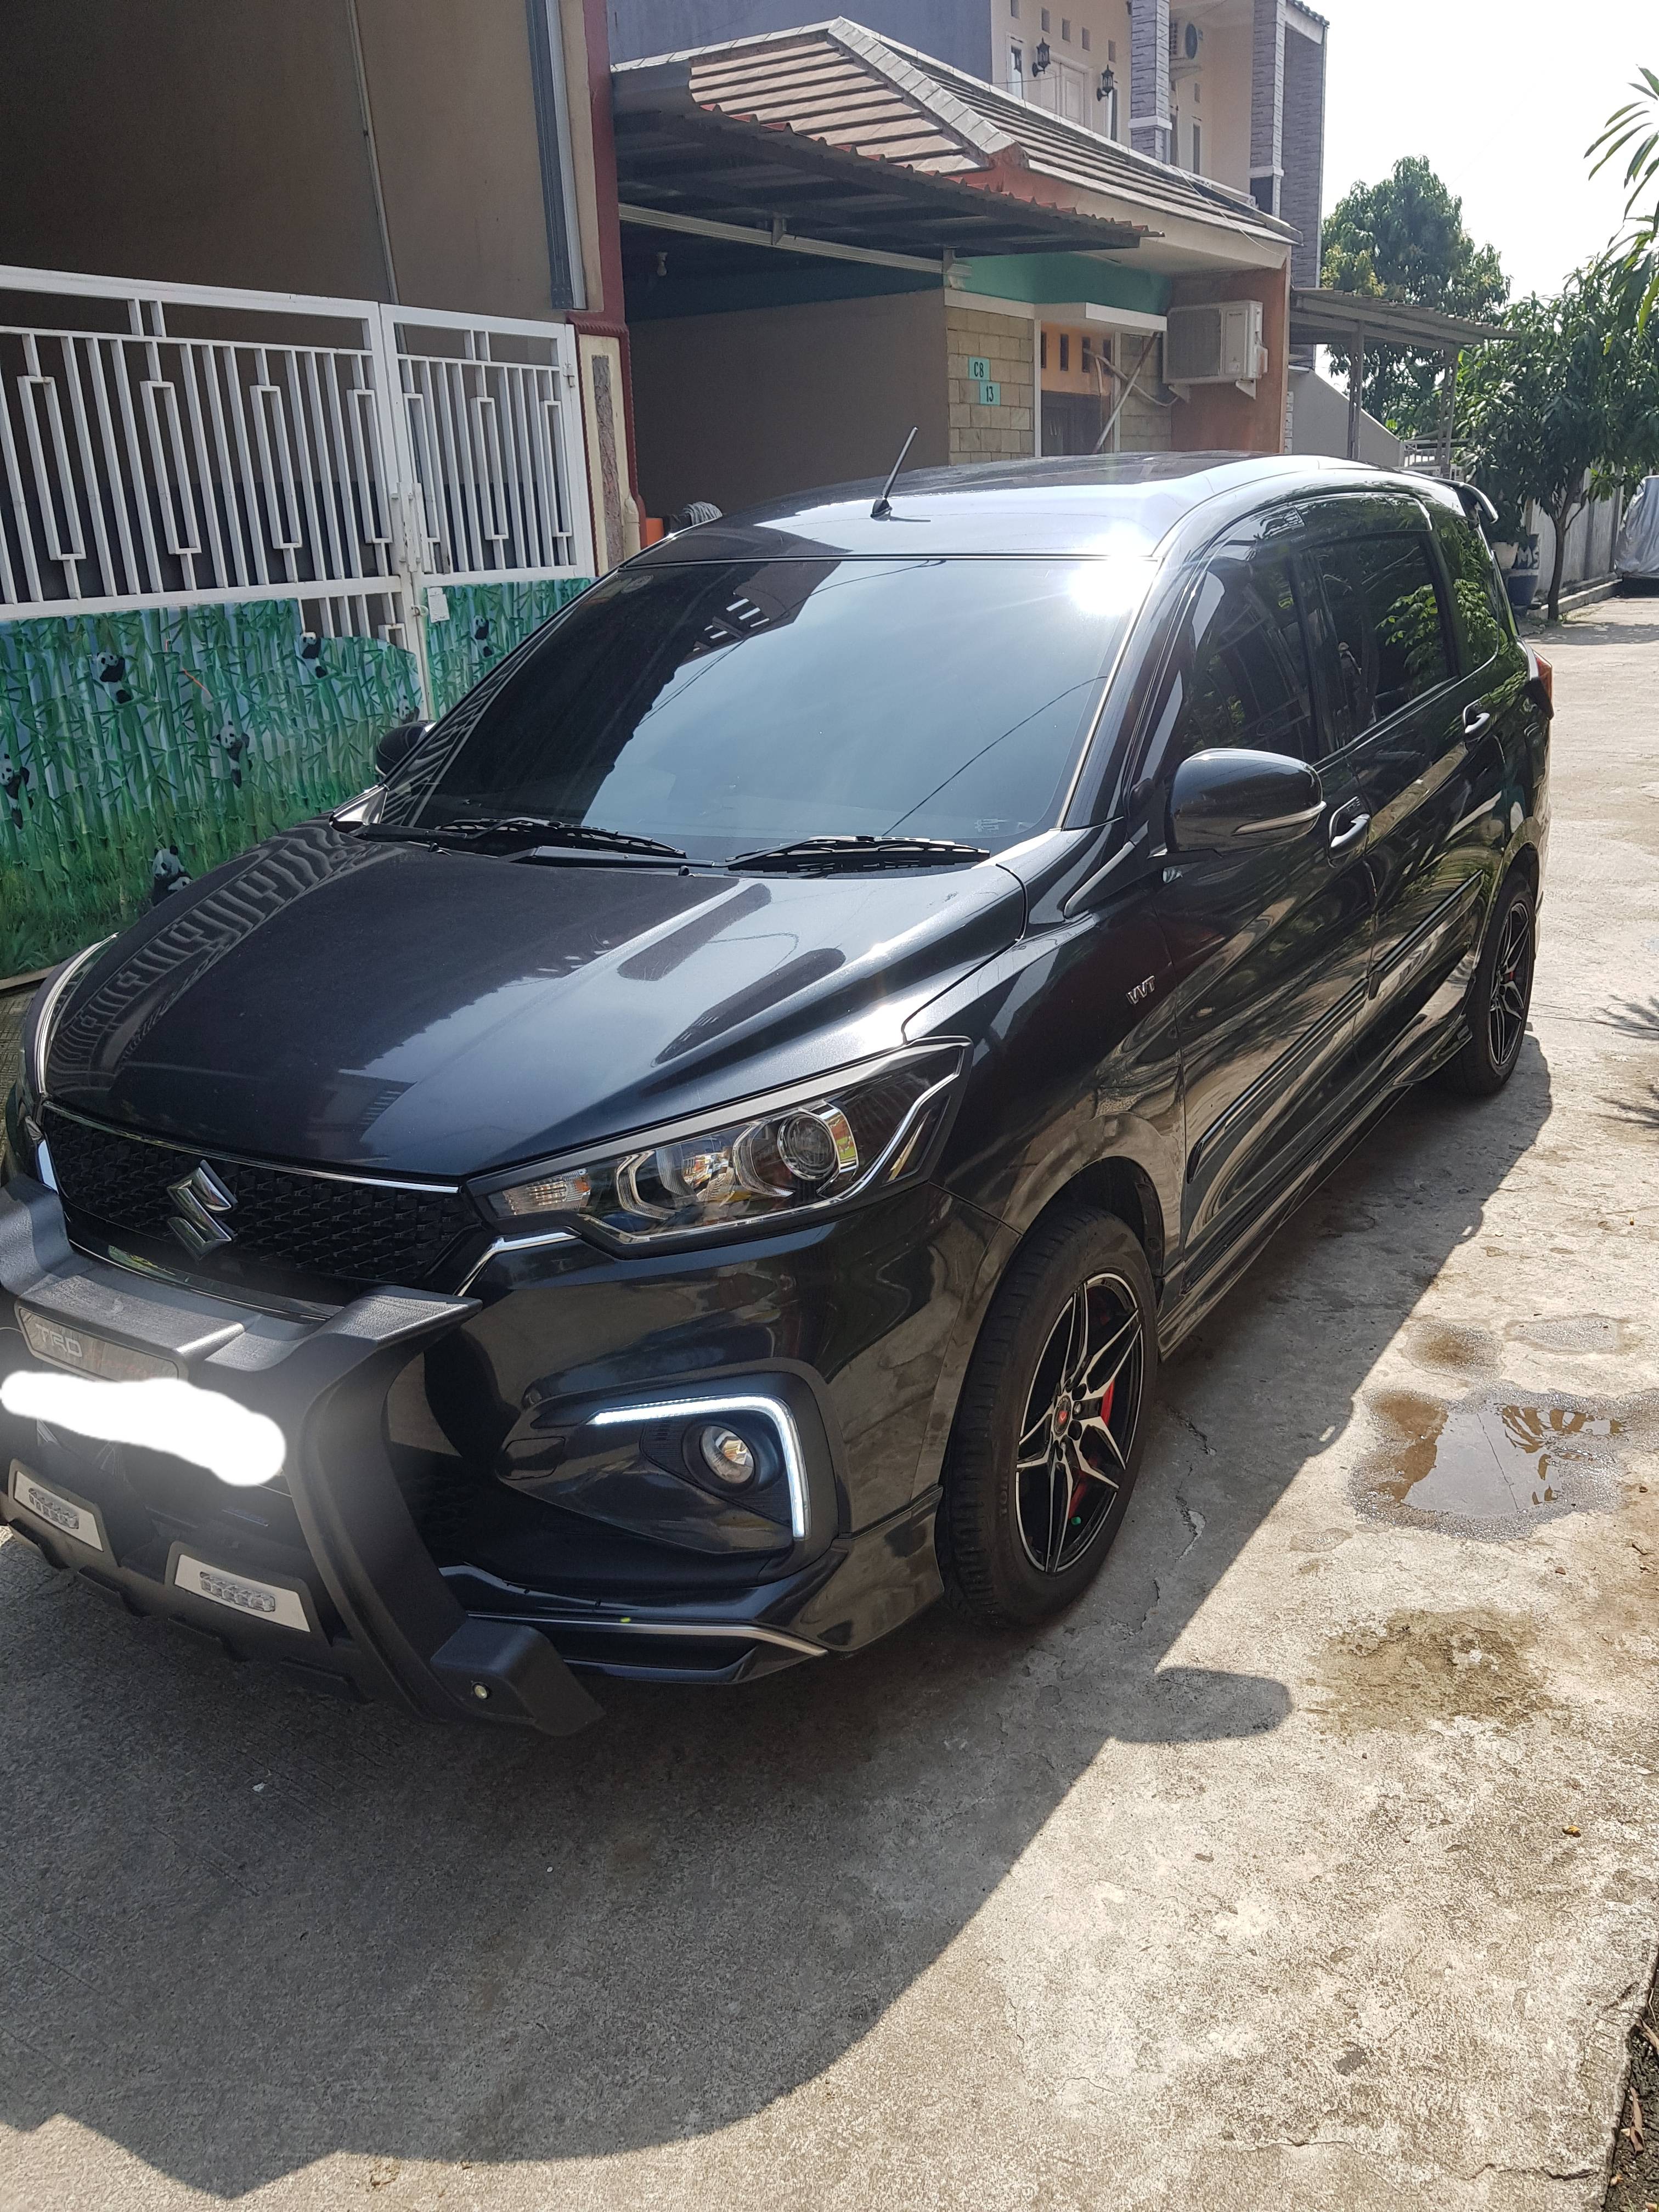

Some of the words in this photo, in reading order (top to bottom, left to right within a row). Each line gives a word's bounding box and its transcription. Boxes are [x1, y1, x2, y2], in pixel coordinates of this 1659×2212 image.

[974, 362, 984, 378] C8
[986, 386, 994, 402] 13
[35, 1323, 83, 1357] TRD
